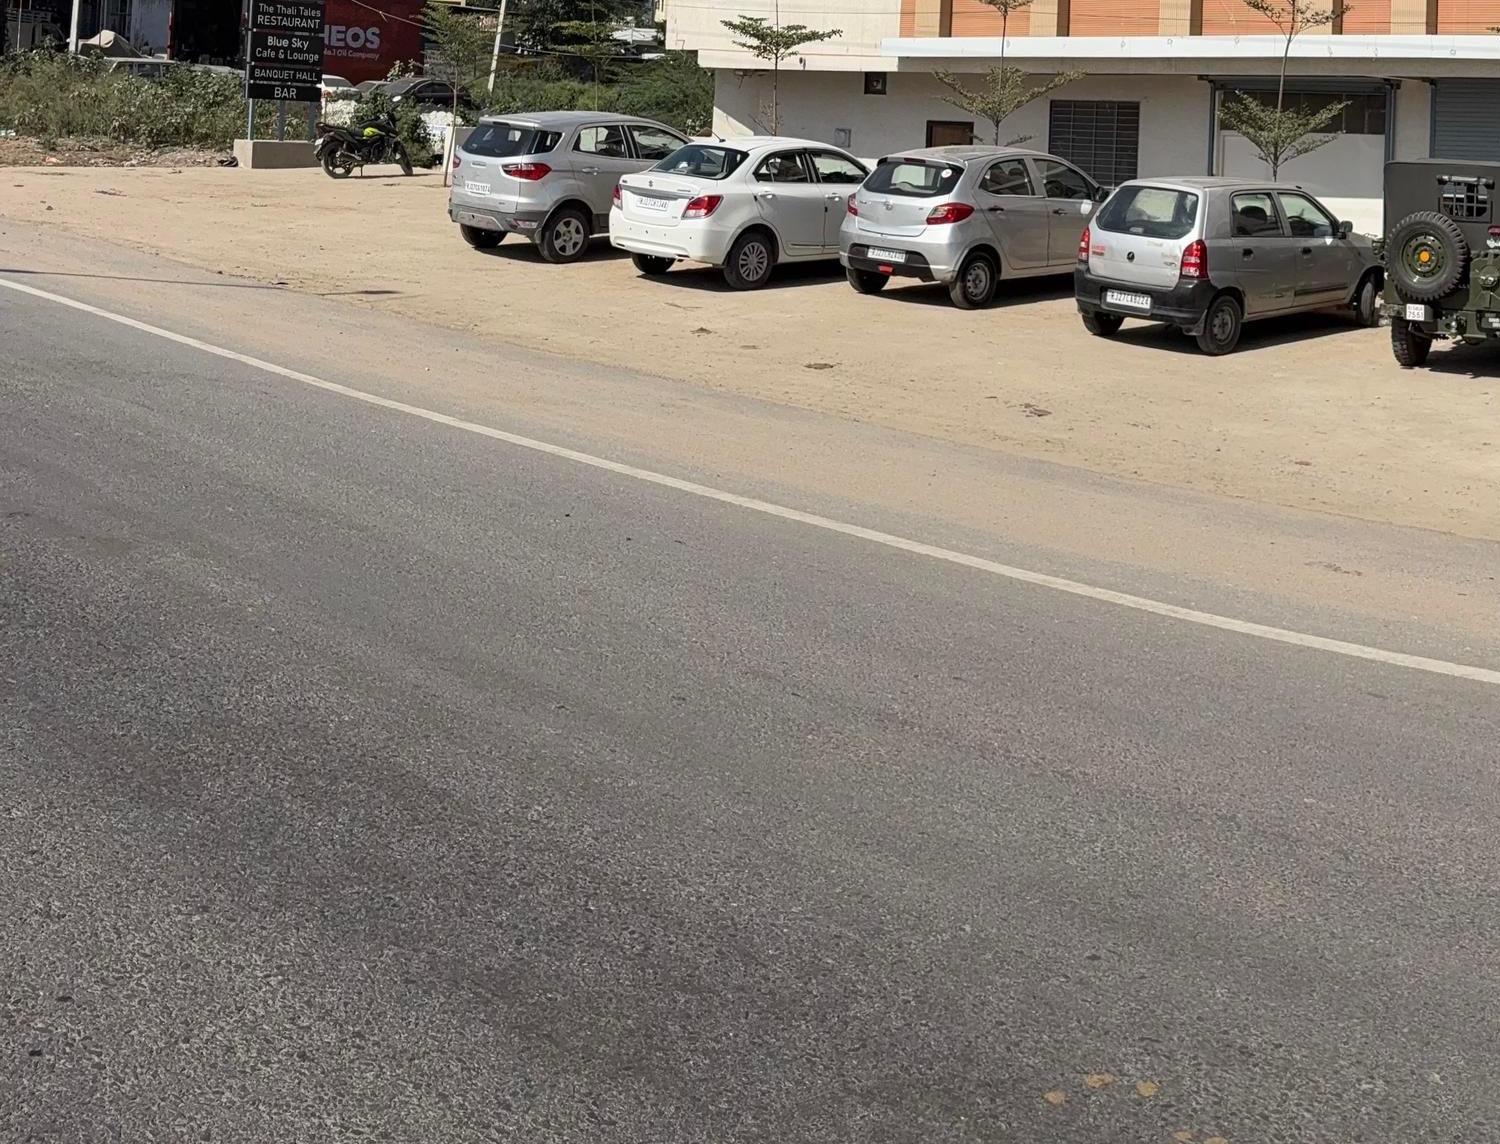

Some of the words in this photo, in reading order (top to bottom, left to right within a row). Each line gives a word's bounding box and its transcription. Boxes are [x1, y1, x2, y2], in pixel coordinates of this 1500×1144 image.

[258, 2, 275, 13] The
[277, 4, 298, 16] Thali
[299, 6, 321, 17] Tales
[257, 15, 321, 29] RESTAURANT
[267, 35, 289, 47] Blue
[291, 37, 310, 51] Sky
[323, 23, 381, 49] EOS
[255, 47, 276, 58] Cafe
[279, 49, 286, 59] &
[287, 50, 320, 63] Lounge
[254, 68, 295, 80] BANQUET
[295, 71, 318, 81] HALL
[274, 87, 298, 99] BAR
